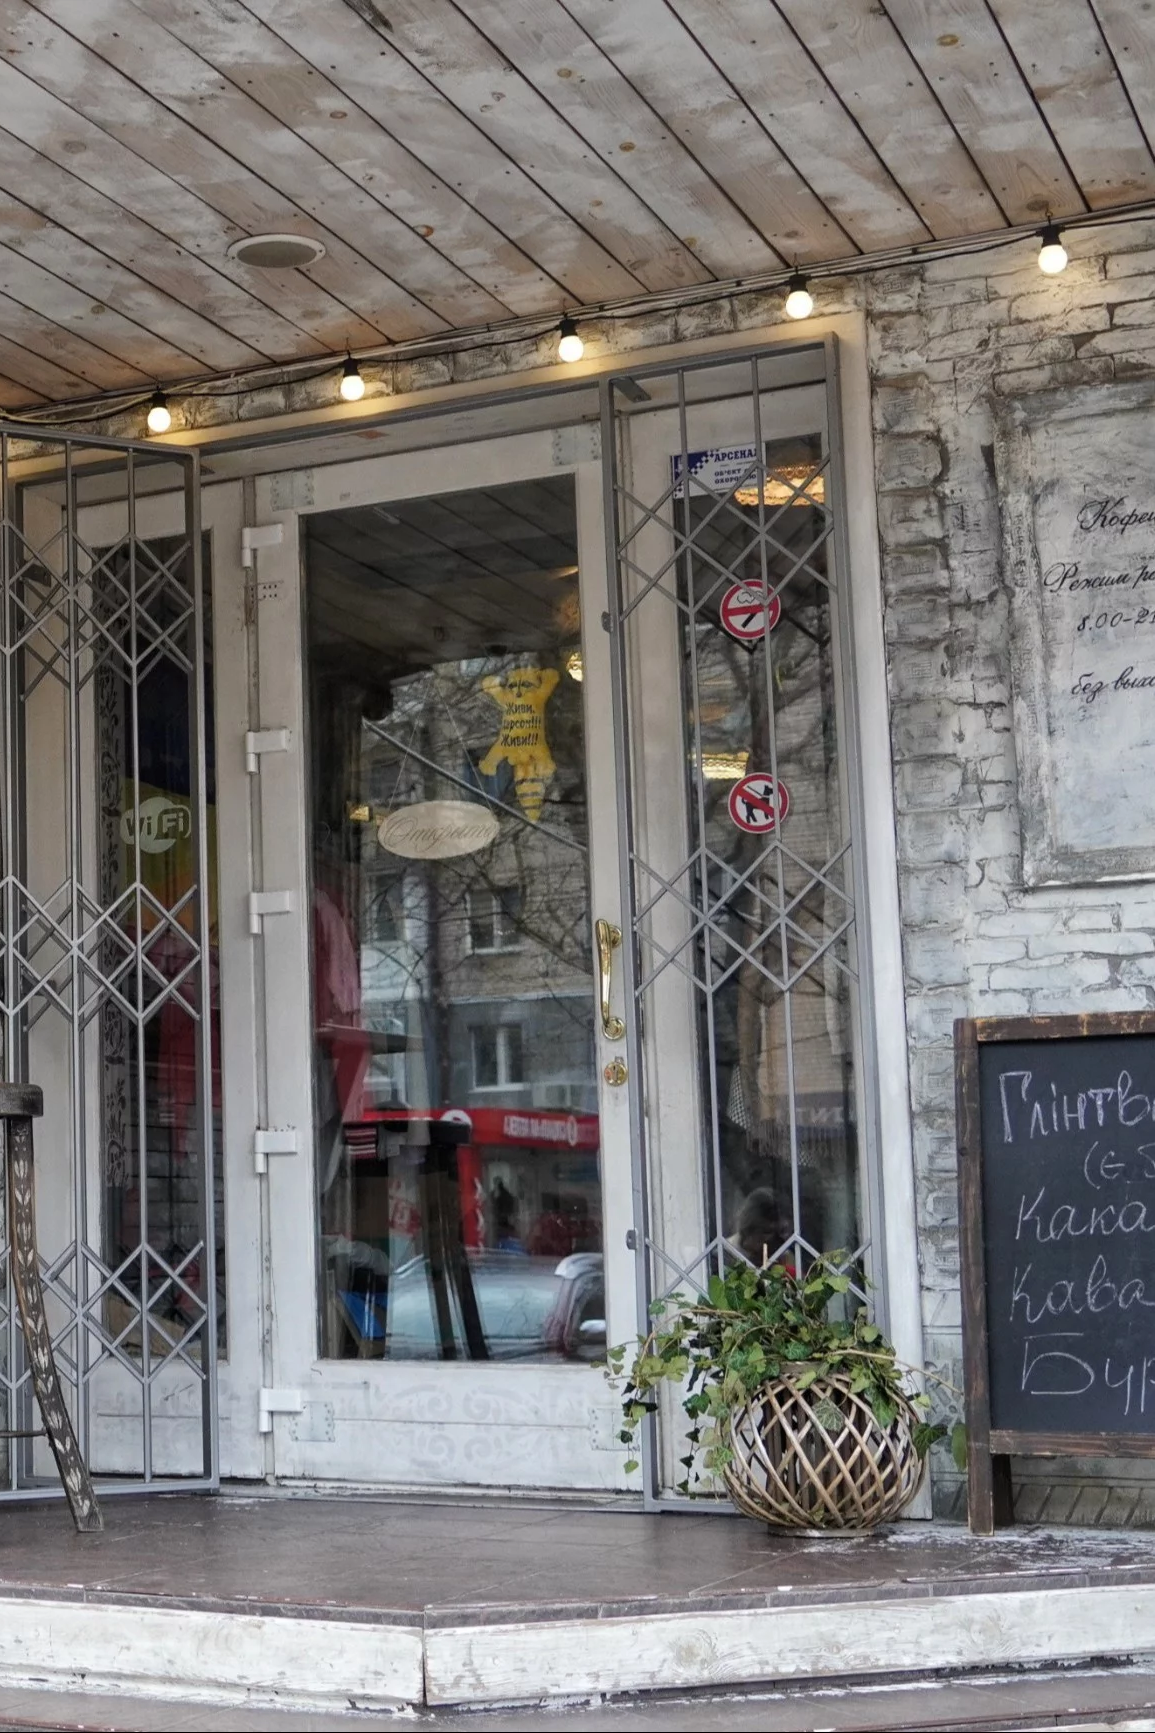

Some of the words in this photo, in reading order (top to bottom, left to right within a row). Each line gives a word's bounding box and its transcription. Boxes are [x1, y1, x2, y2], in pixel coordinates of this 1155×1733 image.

[1044, 561, 1130, 593] Режим
[1071, 672, 1108, 704] без
[999, 1070, 1155, 1143] Глінтв
[1009, 1254, 1155, 1323] Кава
